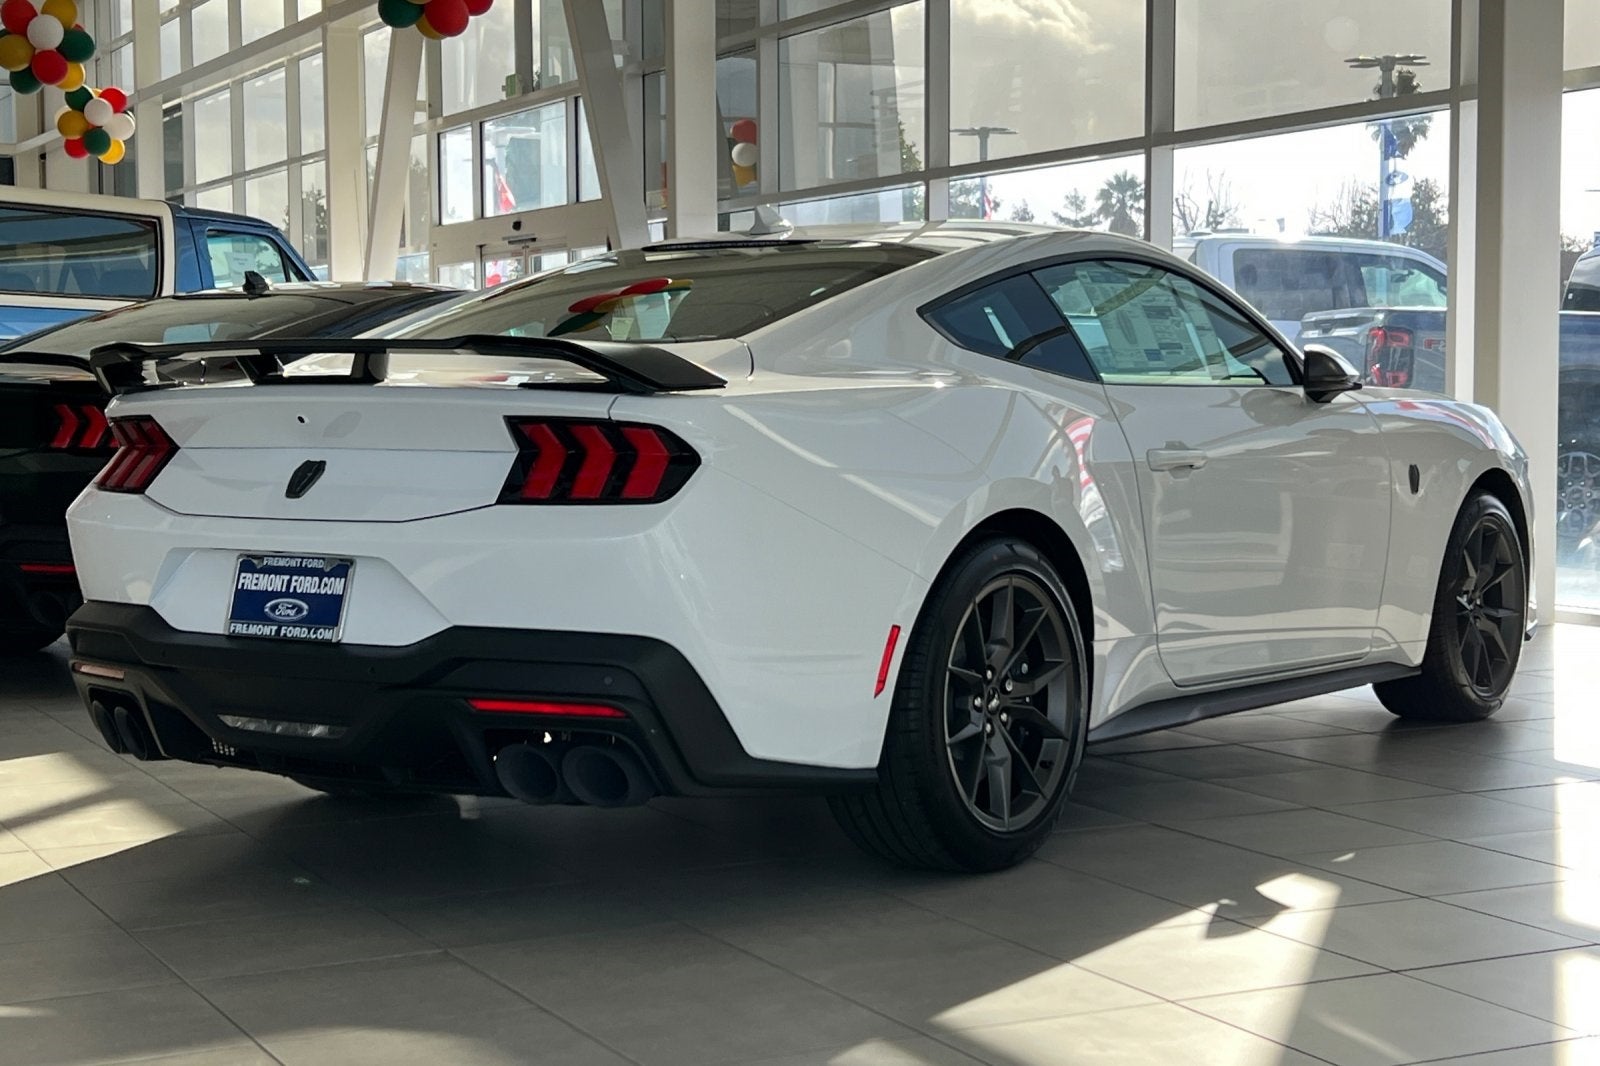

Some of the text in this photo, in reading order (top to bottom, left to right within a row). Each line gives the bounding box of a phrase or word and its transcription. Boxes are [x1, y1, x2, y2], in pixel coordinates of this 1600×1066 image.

[263, 556, 325, 568] FREMONT FORD
[238, 572, 346, 595] FREMONT FORD.COM
[275, 603, 297, 616] Ford
[230, 623, 333, 640] FREMONT FORD.COM
